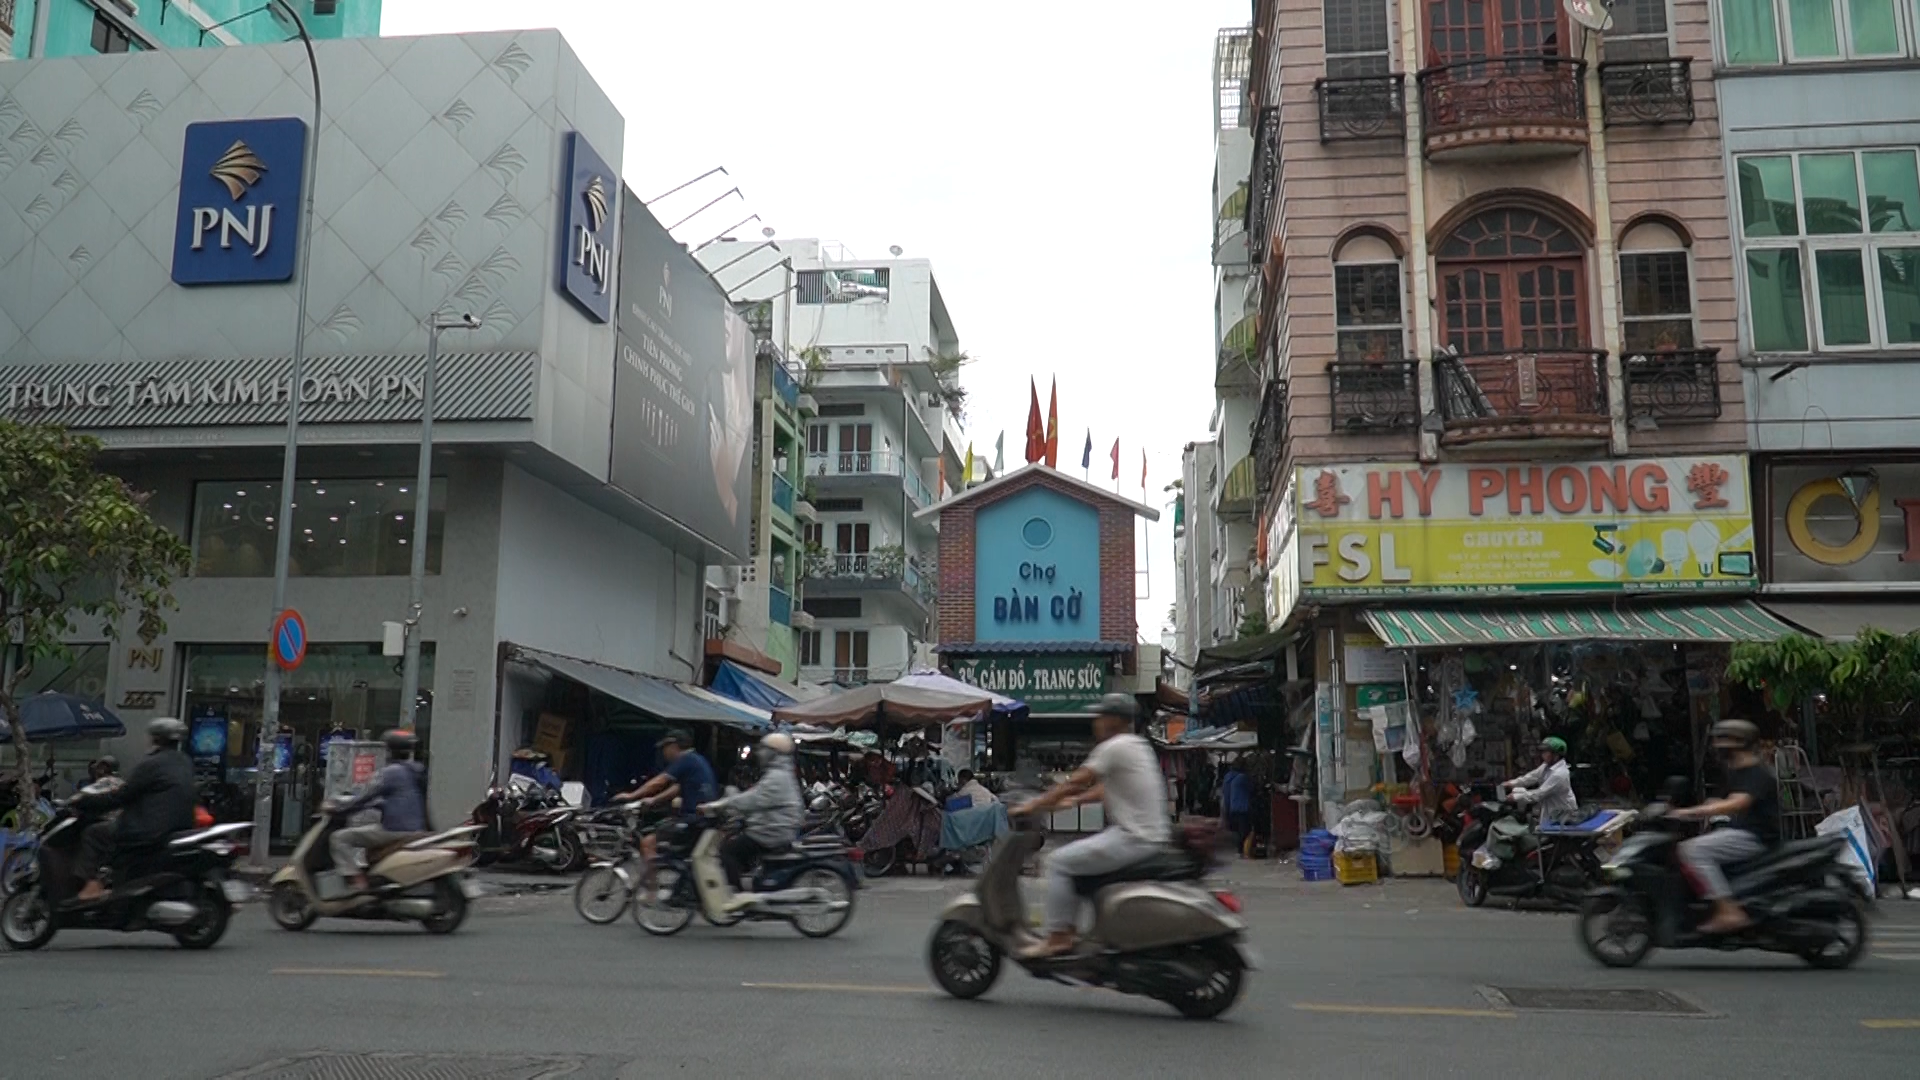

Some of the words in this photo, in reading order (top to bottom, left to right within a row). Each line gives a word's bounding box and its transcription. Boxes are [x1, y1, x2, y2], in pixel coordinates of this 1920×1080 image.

[190, 203, 275, 258] PNJ
[574, 224, 610, 295] PNJ
[658, 285, 673, 318] PNJ
[7, 380, 111, 410] TRUNG
[125, 372, 192, 407] TÂM
[202, 377, 261, 405] KIM
[381, 373, 426, 402] PN
[1367, 469, 1441, 519] HY
[1468, 462, 1669, 516] PHONG
[1463, 526, 1545, 548] CHUYÊN
[1018, 561, 1057, 585] Chợ
[1300, 532, 1412, 584] FSL
[993, 587, 1039, 621] BÀN
[1050, 585, 1083, 621] CỜ
[127, 646, 164, 673] PNJ
[1033, 668, 1075, 691] TRANG
[1077, 661, 1102, 691] SỨC
